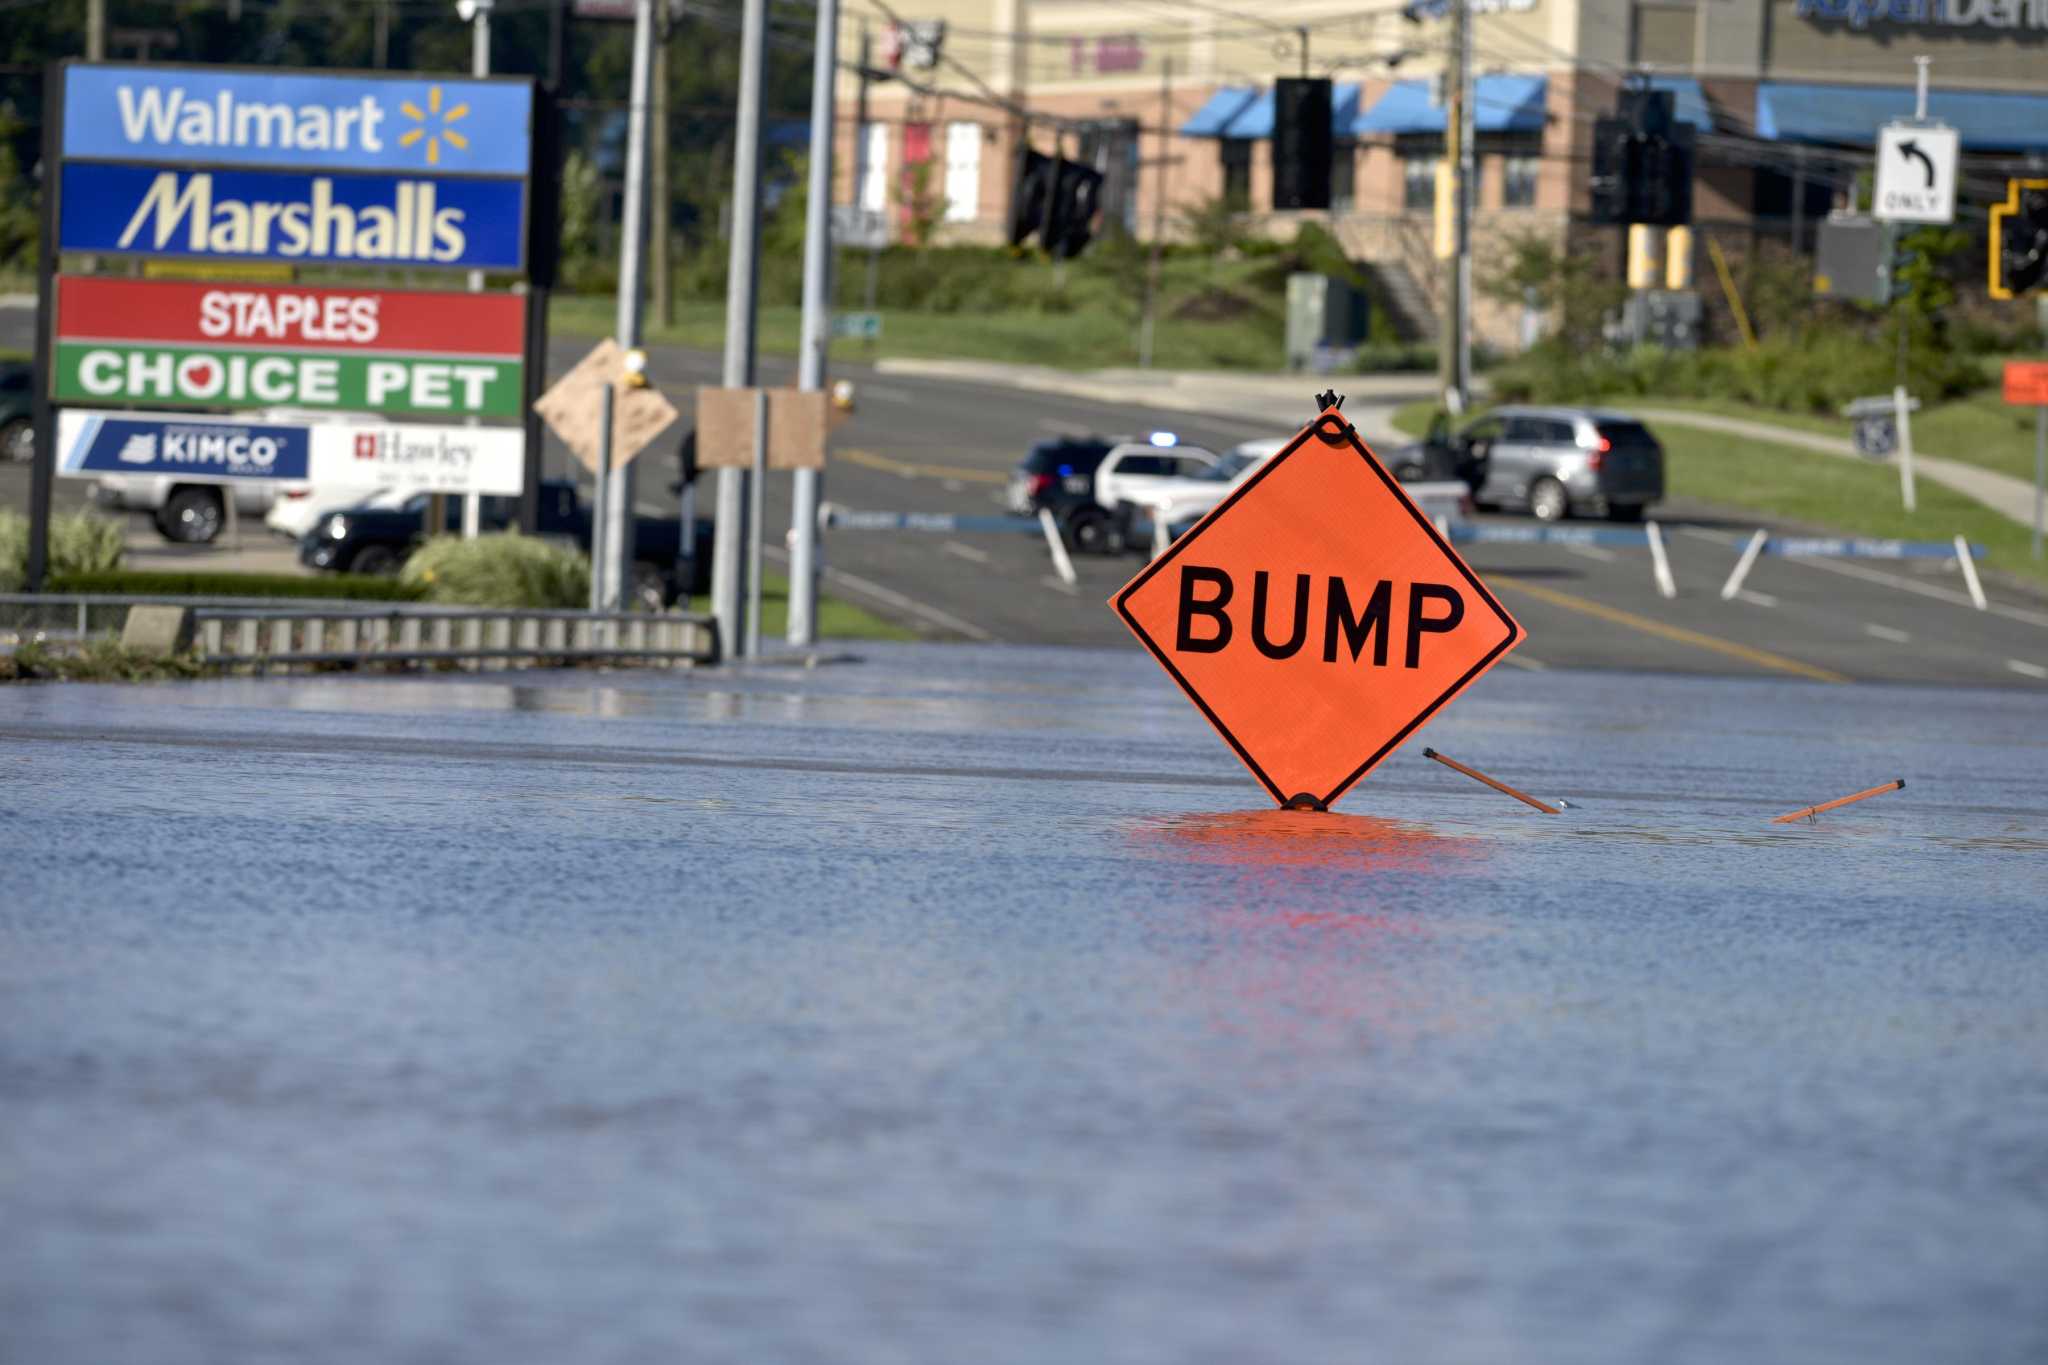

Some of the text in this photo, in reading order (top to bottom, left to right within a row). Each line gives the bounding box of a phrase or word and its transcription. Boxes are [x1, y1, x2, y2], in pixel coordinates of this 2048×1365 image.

[117, 86, 384, 152] Walmart
[117, 172, 467, 262] Marshalls
[1885, 192, 1941, 212] ONLY
[199, 291, 380, 343] STAPLES
[78, 350, 498, 410] CHOICE PET
[162, 433, 278, 466] KIMCO
[1176, 565, 1465, 669] BUMP
